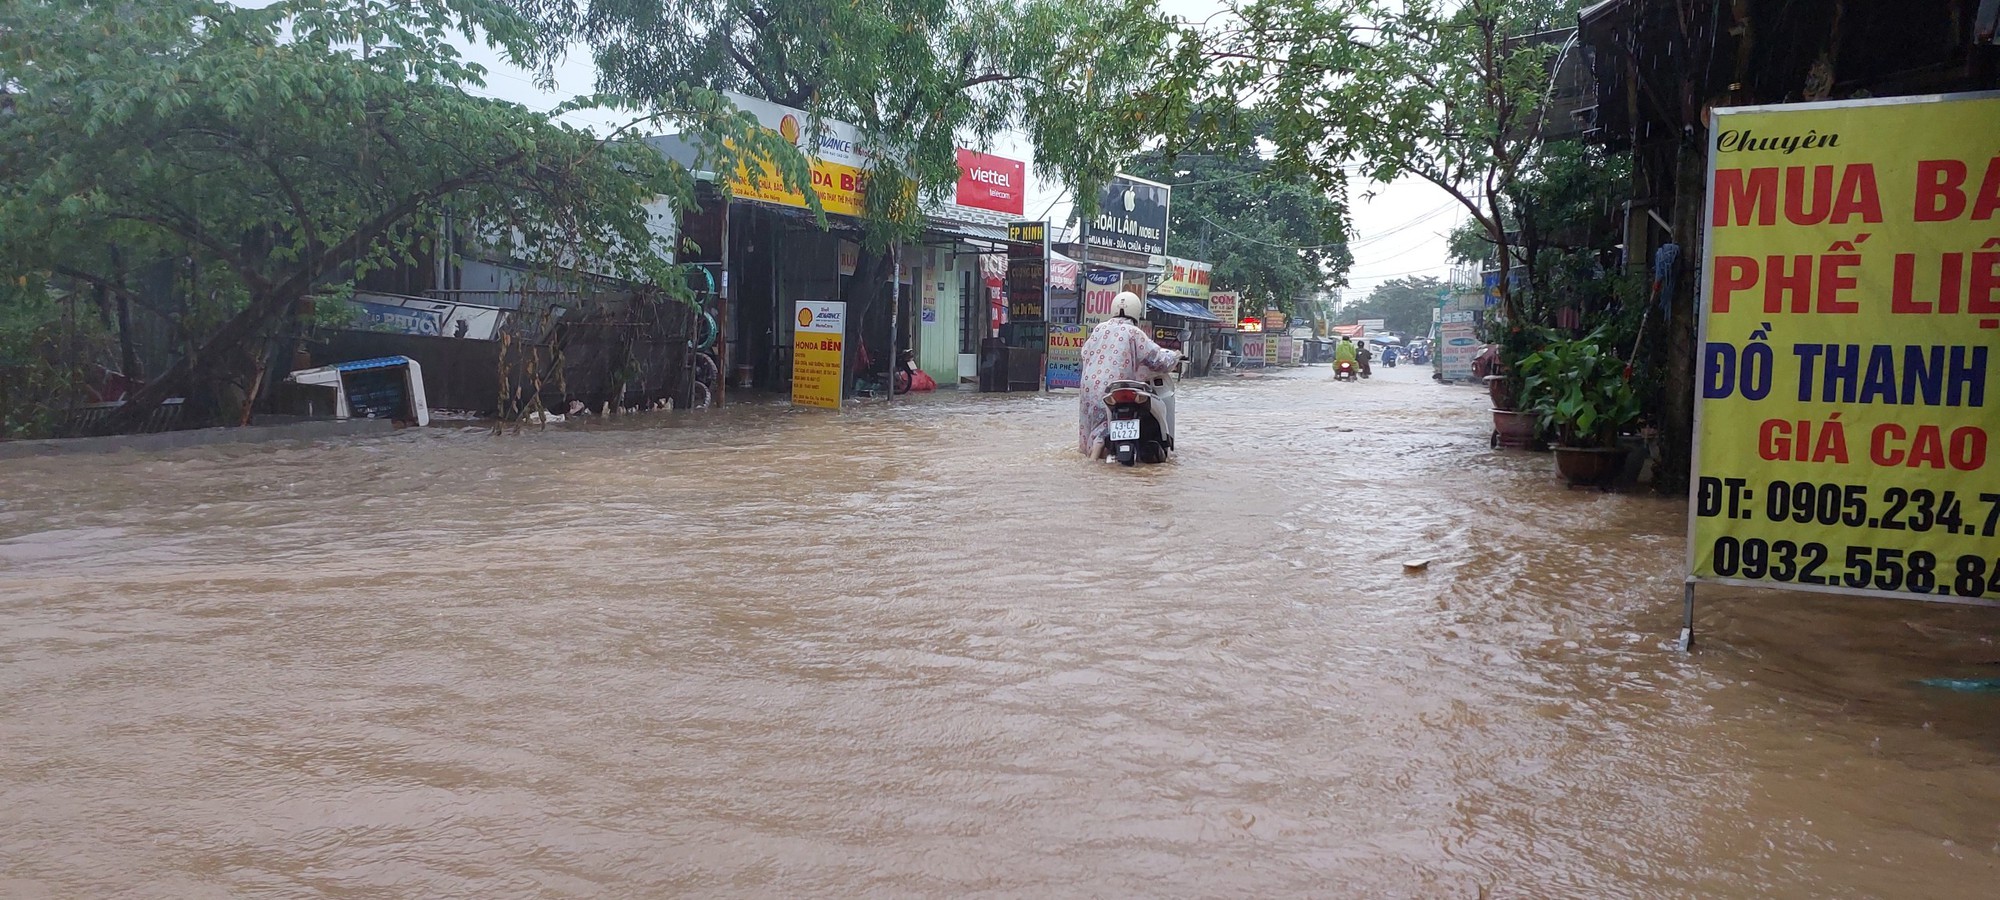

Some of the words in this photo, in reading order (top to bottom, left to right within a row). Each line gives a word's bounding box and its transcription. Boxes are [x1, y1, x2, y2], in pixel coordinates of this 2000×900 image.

[1716, 129, 1841, 155] Chuyên
[969, 167, 1010, 188] viettel
[989, 188, 1011, 199] telecom
[1711, 163, 1884, 227] MUA
[1010, 225, 1020, 240] ÉP
[1022, 225, 1043, 241] KÍNH
[1093, 211, 1116, 232] HOÀI
[1117, 215, 1138, 236] LÂM
[1138, 226, 1160, 239] MOBILE
[1102, 236, 1113, 247] BÁN
[1116, 237, 1127, 250] SỬA
[1127, 240, 1142, 251] CHỮA
[1711, 233, 1872, 314] PHẾ
[795, 341, 819, 350] HONDA
[820, 338, 842, 352] BỀN
[1050, 333, 1070, 347] RỬA
[1702, 322, 1773, 401] ĐỒ
[1792, 342, 1989, 408] THANH
[1758, 412, 1850, 464] GIÁ
[1869, 423, 1988, 471] CAO
[1697, 476, 1753, 520] ĐT:
[1766, 480, 2000, 537] 0905.234.7
